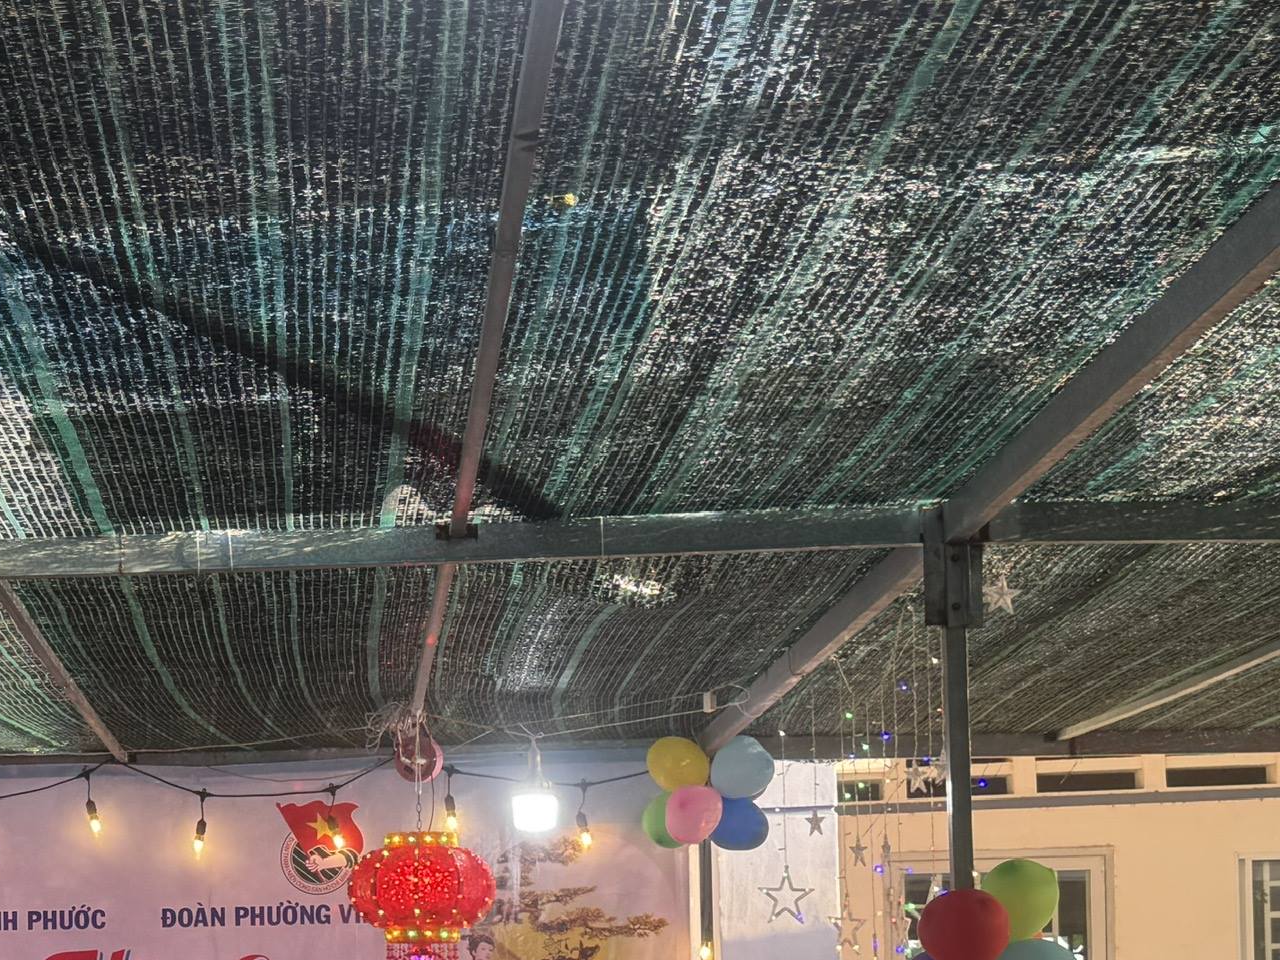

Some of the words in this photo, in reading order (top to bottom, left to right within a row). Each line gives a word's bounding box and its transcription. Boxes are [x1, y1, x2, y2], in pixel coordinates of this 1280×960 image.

[27, 905, 106, 931] PHƯỚC
[161, 902, 226, 928] ĐOÀN
[234, 900, 331, 926] PHƯỜNG
